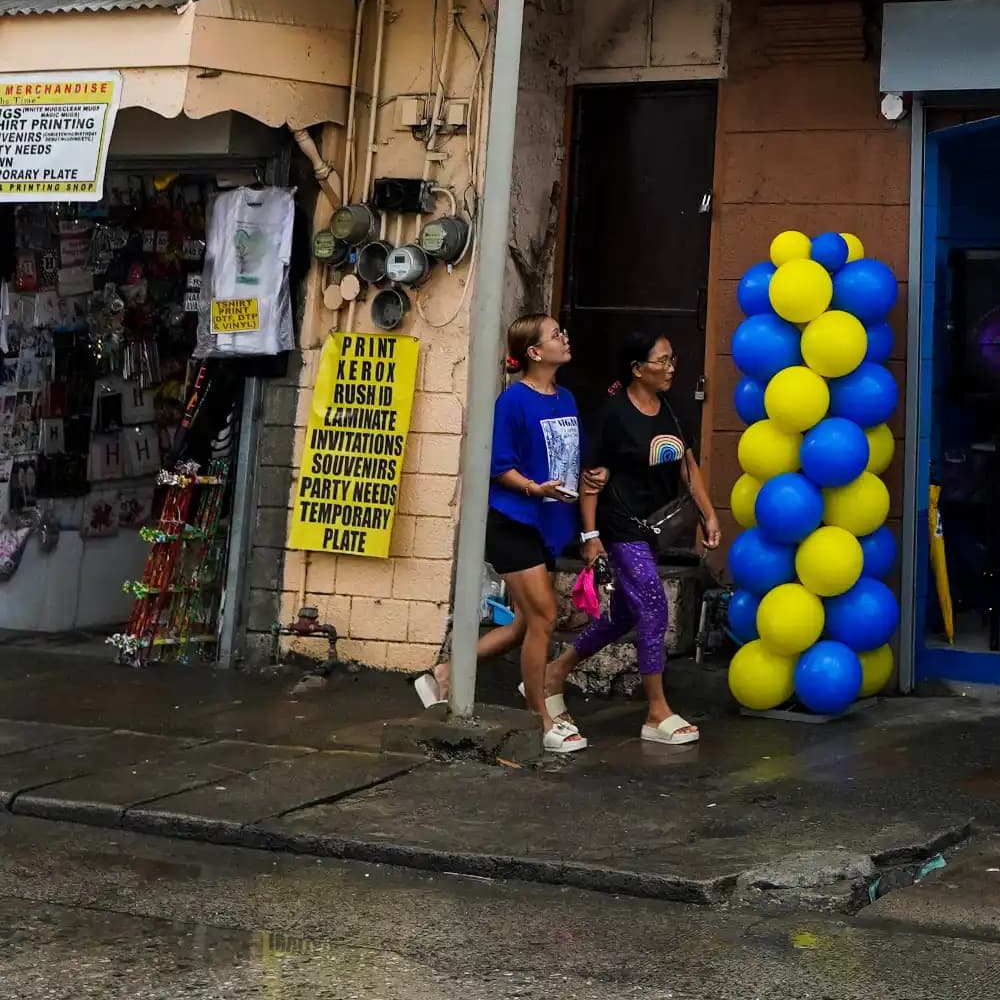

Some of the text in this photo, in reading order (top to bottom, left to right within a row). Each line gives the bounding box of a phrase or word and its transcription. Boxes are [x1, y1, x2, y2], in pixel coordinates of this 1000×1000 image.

[6, 83, 108, 96] MERCHANDISE
[0, 108, 21, 119] GS
[32, 118, 94, 130] PRINTING
[0, 132, 42, 143] VENIRS
[15, 145, 52, 154] NEEDS
[0, 169, 78, 180] ORARY PLATE
[10, 184, 60, 192] PRINTING
[342, 337, 396, 358] PRINT
[336, 360, 395, 383] XEROX
[334, 384, 393, 406] RUSH ID
[324, 407, 396, 432] LAMINATE
[310, 429, 403, 456] INVITATIONS
[312, 453, 396, 480] SOUVENIRS
[300, 477, 397, 506] PARTY NEEDS
[300, 501, 390, 530] TEMPORARY
[322, 528, 367, 552] PLATE
